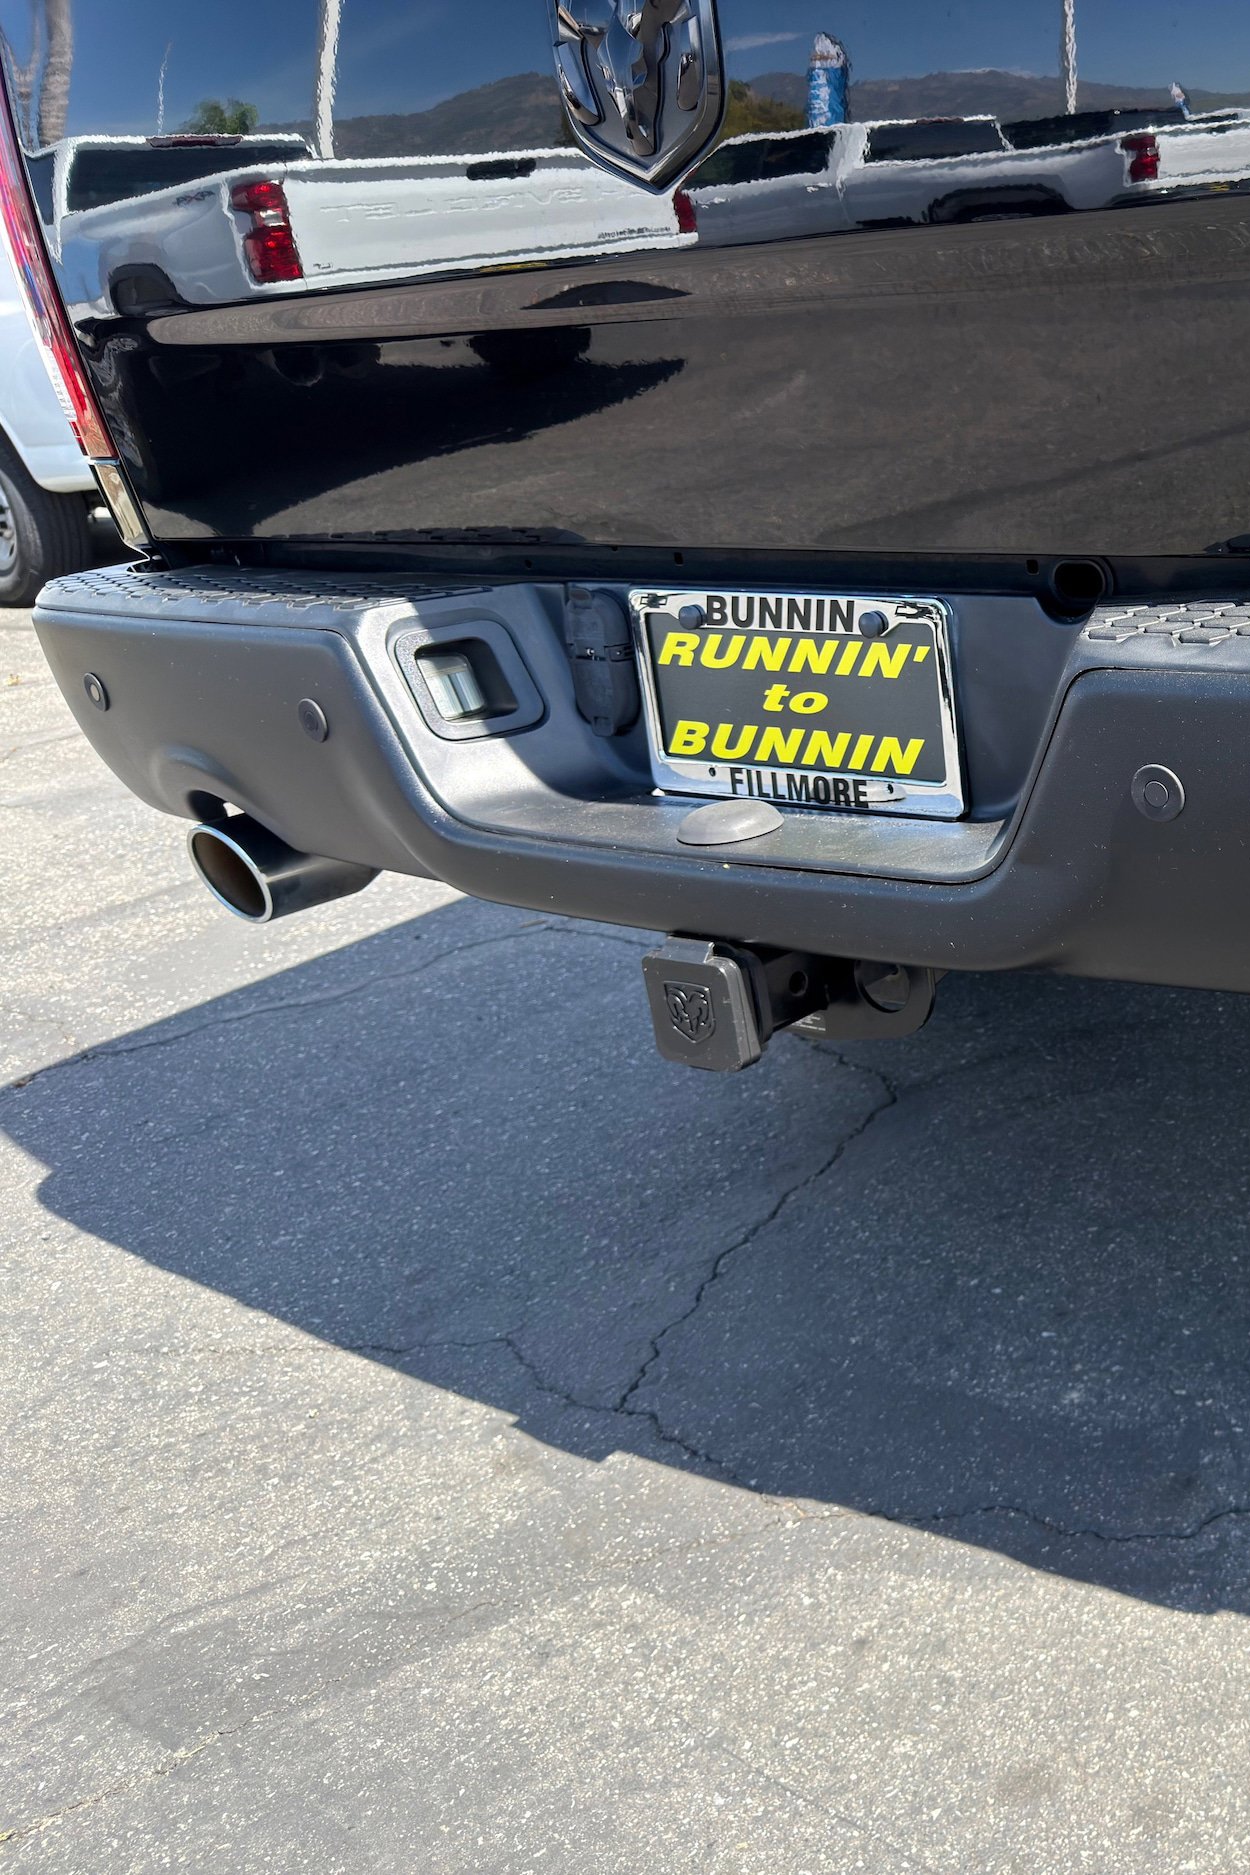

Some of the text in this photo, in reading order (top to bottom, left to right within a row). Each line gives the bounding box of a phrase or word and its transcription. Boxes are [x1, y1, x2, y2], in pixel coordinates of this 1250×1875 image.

[706, 595, 855, 632] BUNNIN
[658, 632, 931, 679] RUNNIN'
[763, 684, 829, 714] to
[668, 720, 925, 775] BUNNIN
[729, 767, 869, 808] FILLMORE
